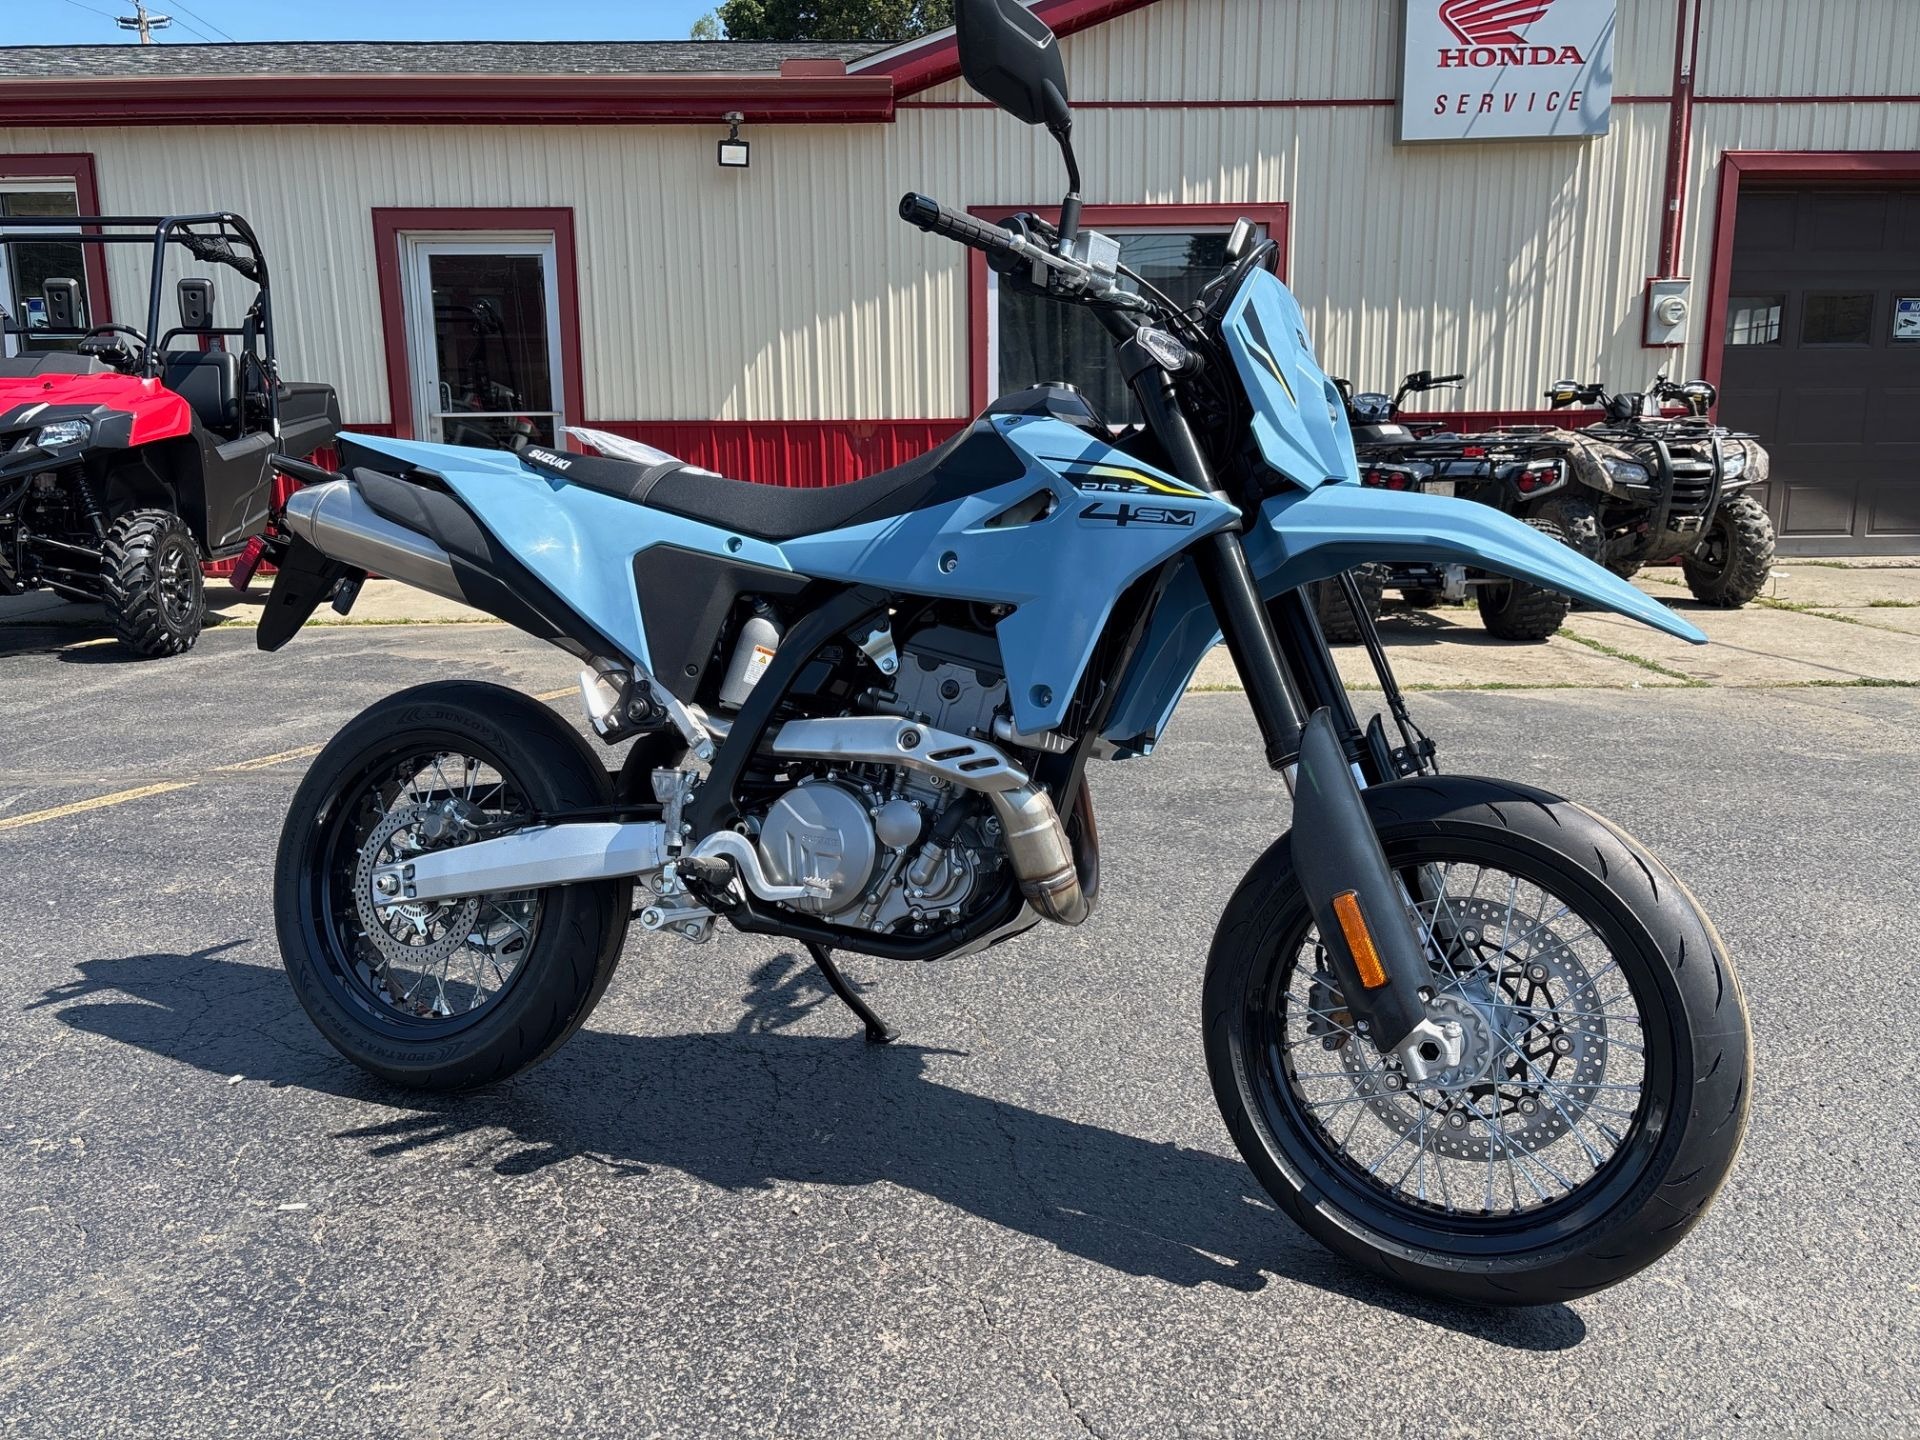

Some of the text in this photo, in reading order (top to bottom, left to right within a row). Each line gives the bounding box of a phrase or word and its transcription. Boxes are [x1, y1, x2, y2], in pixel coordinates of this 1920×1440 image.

[1437, 46, 1586, 68] HONDA
[1434, 91, 1582, 115] SERVICE
[528, 449, 572, 471] SUZUKI
[1080, 482, 1150, 493] DR-Z
[434, 710, 491, 736] DUNLOP
[356, 1038, 436, 1062] SPORTMAX
